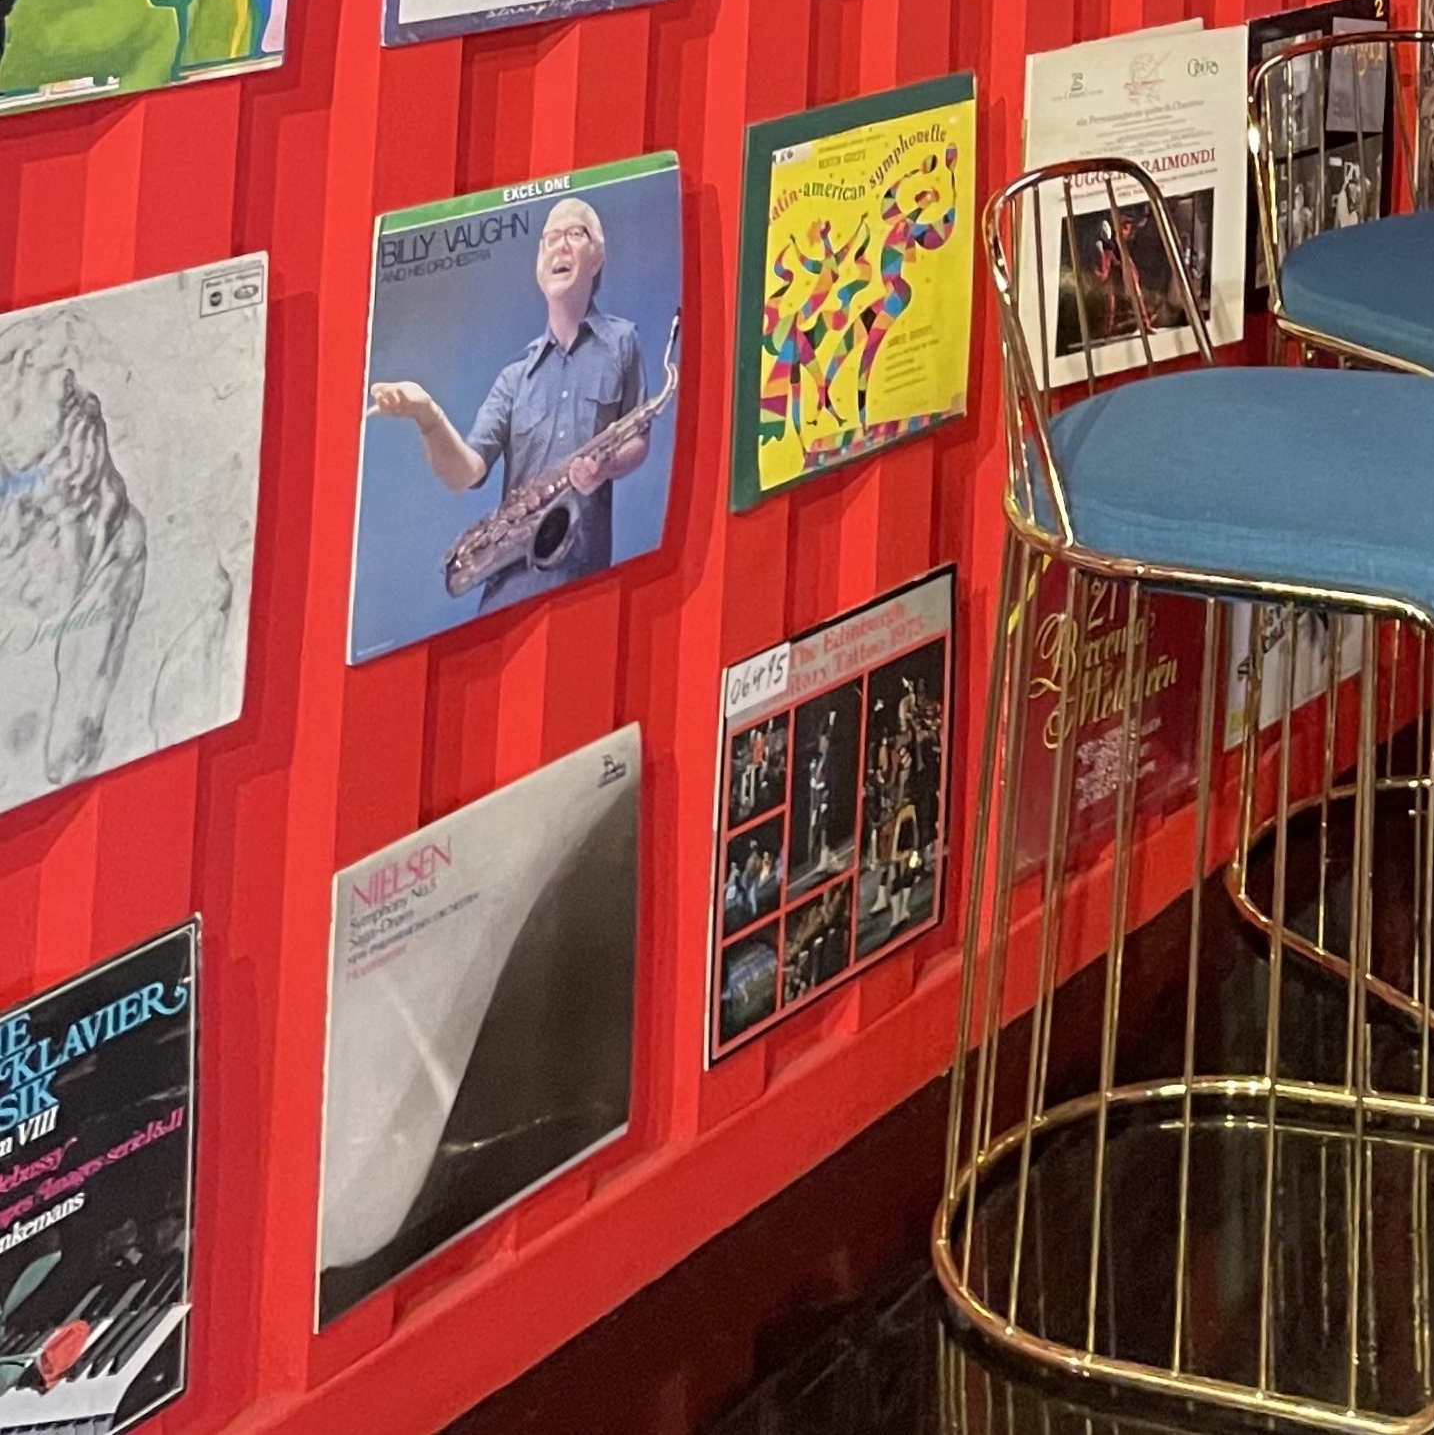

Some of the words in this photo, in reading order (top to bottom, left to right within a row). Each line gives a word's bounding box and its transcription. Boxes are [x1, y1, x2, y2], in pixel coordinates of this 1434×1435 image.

[1141, 147, 1216, 174] RAIMONDI
[503, 182, 543, 202] EXCEL
[544, 175, 572, 193] ONE
[381, 230, 436, 269] BILLY
[443, 209, 530, 253] VAUGHN
[382, 268, 406, 283] AND
[426, 248, 492, 275] ORCHESTRA
[351, 833, 453, 915] NIELSEN
[18, 1106, 59, 1146] VIII
